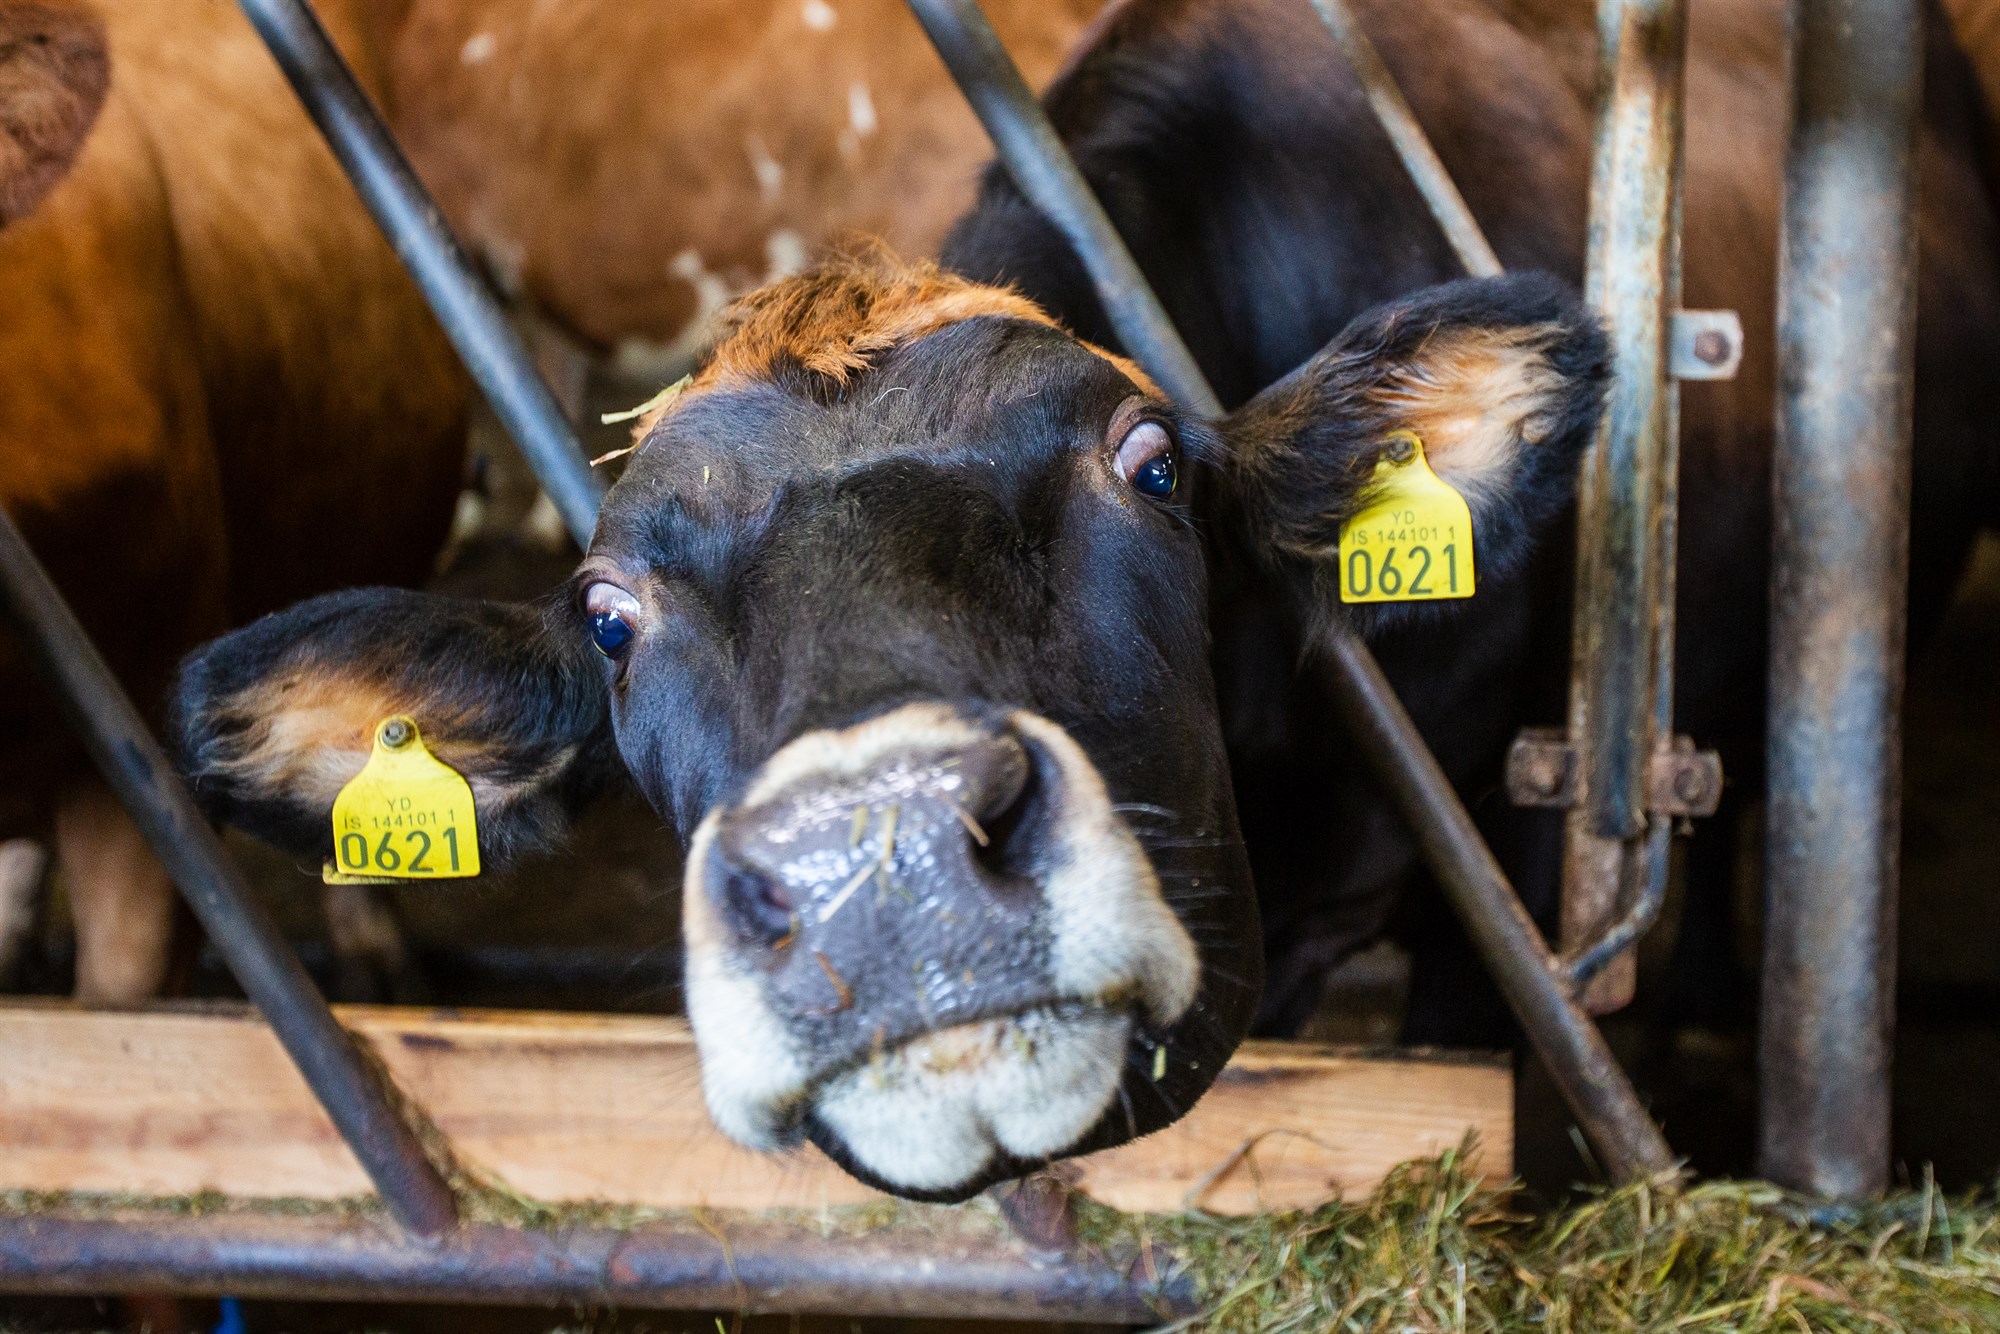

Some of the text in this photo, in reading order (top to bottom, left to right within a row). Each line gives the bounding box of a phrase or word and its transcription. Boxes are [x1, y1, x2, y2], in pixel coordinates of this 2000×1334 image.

[1392, 511, 1415, 525] YD
[1352, 526, 1455, 545] IS 144101 1
[1348, 544, 1457, 597] 0621
[387, 797, 411, 812] YD
[344, 809, 455, 830] IS 144101 1
[341, 827, 459, 873] 0621
